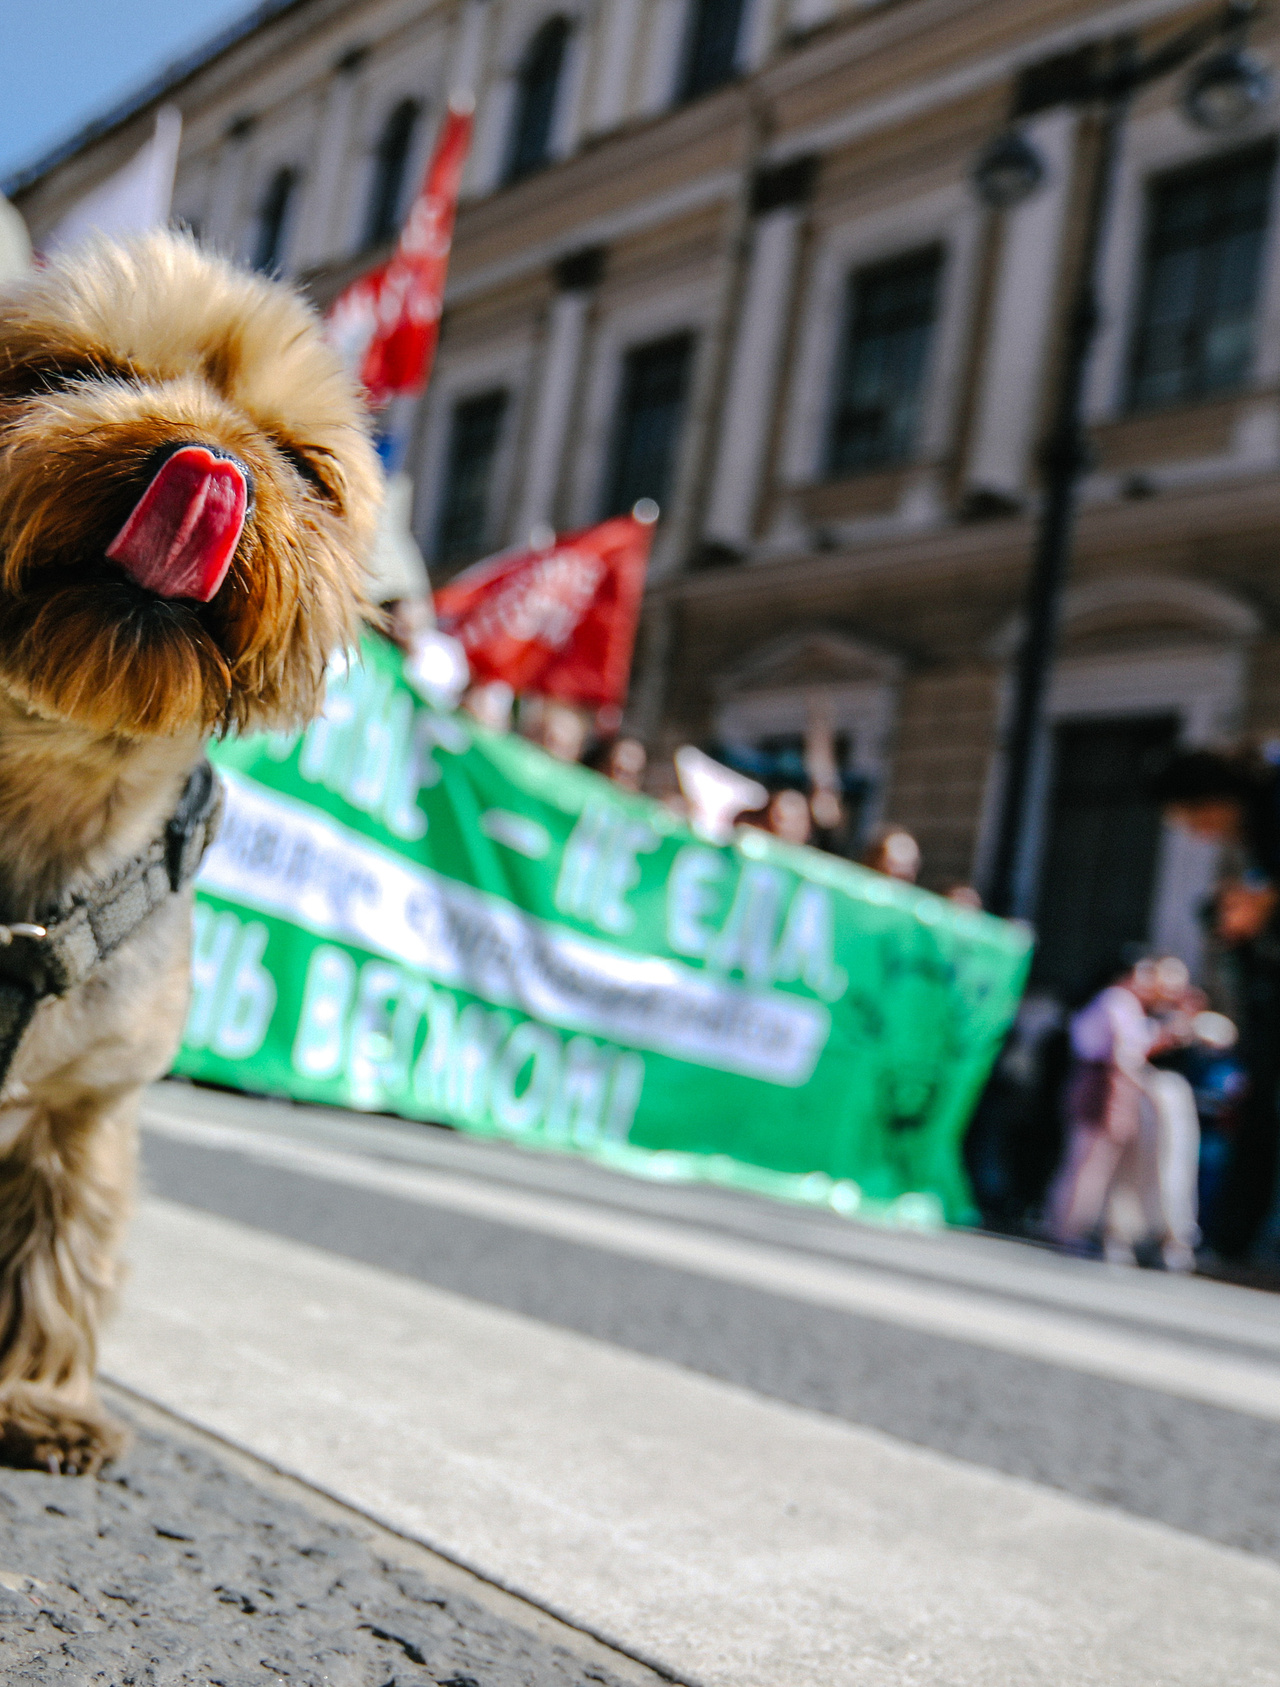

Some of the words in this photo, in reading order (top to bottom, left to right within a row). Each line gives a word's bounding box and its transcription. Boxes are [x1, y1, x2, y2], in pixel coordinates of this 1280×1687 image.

[280, 645, 471, 842] НЫЕ
[554, 798, 662, 936] НЕ
[182, 903, 278, 1060] НЬ
